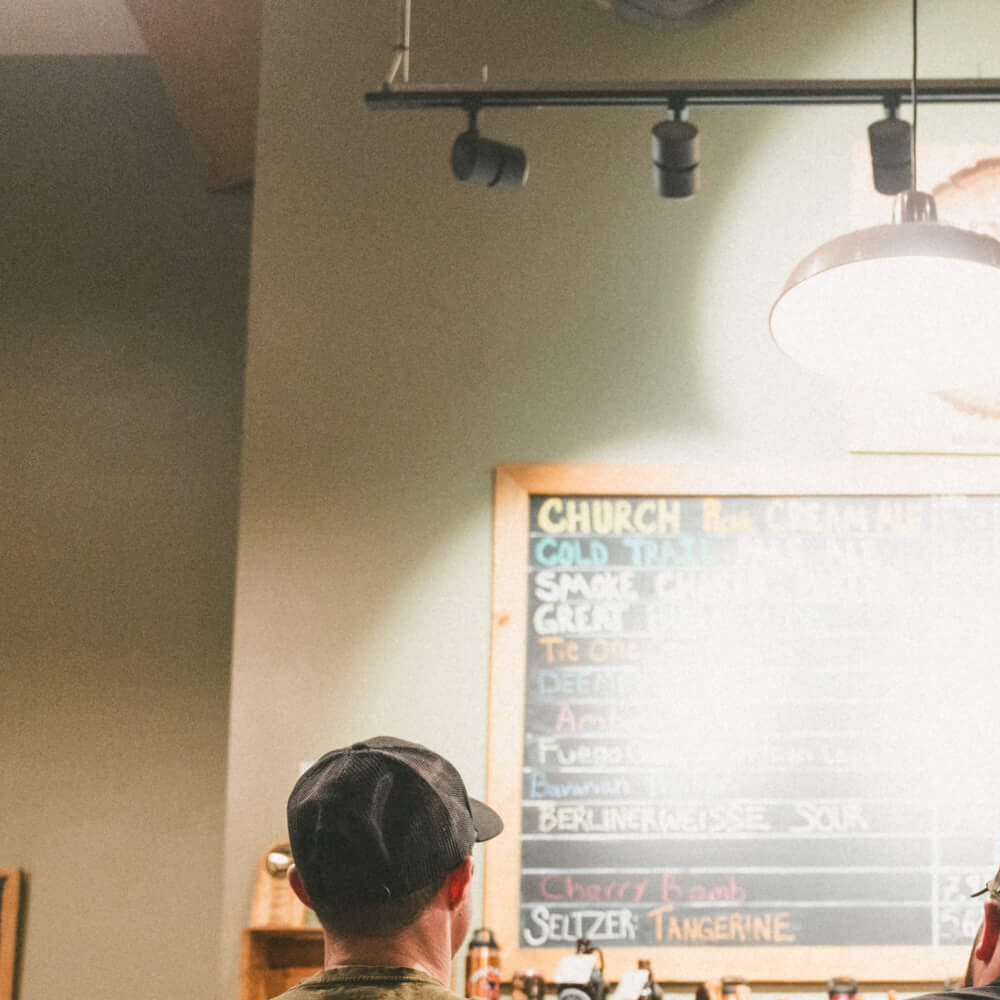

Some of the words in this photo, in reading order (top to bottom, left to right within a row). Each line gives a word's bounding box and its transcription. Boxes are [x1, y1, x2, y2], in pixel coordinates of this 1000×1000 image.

[537, 497, 681, 534] CHURCH
[535, 537, 609, 567] COLD
[534, 570, 638, 603] SMOKE
[533, 602, 626, 635] GREAT
[540, 873, 648, 903] Cherry
[660, 872, 747, 903] Bomb
[648, 904, 796, 942] TANGERINE
